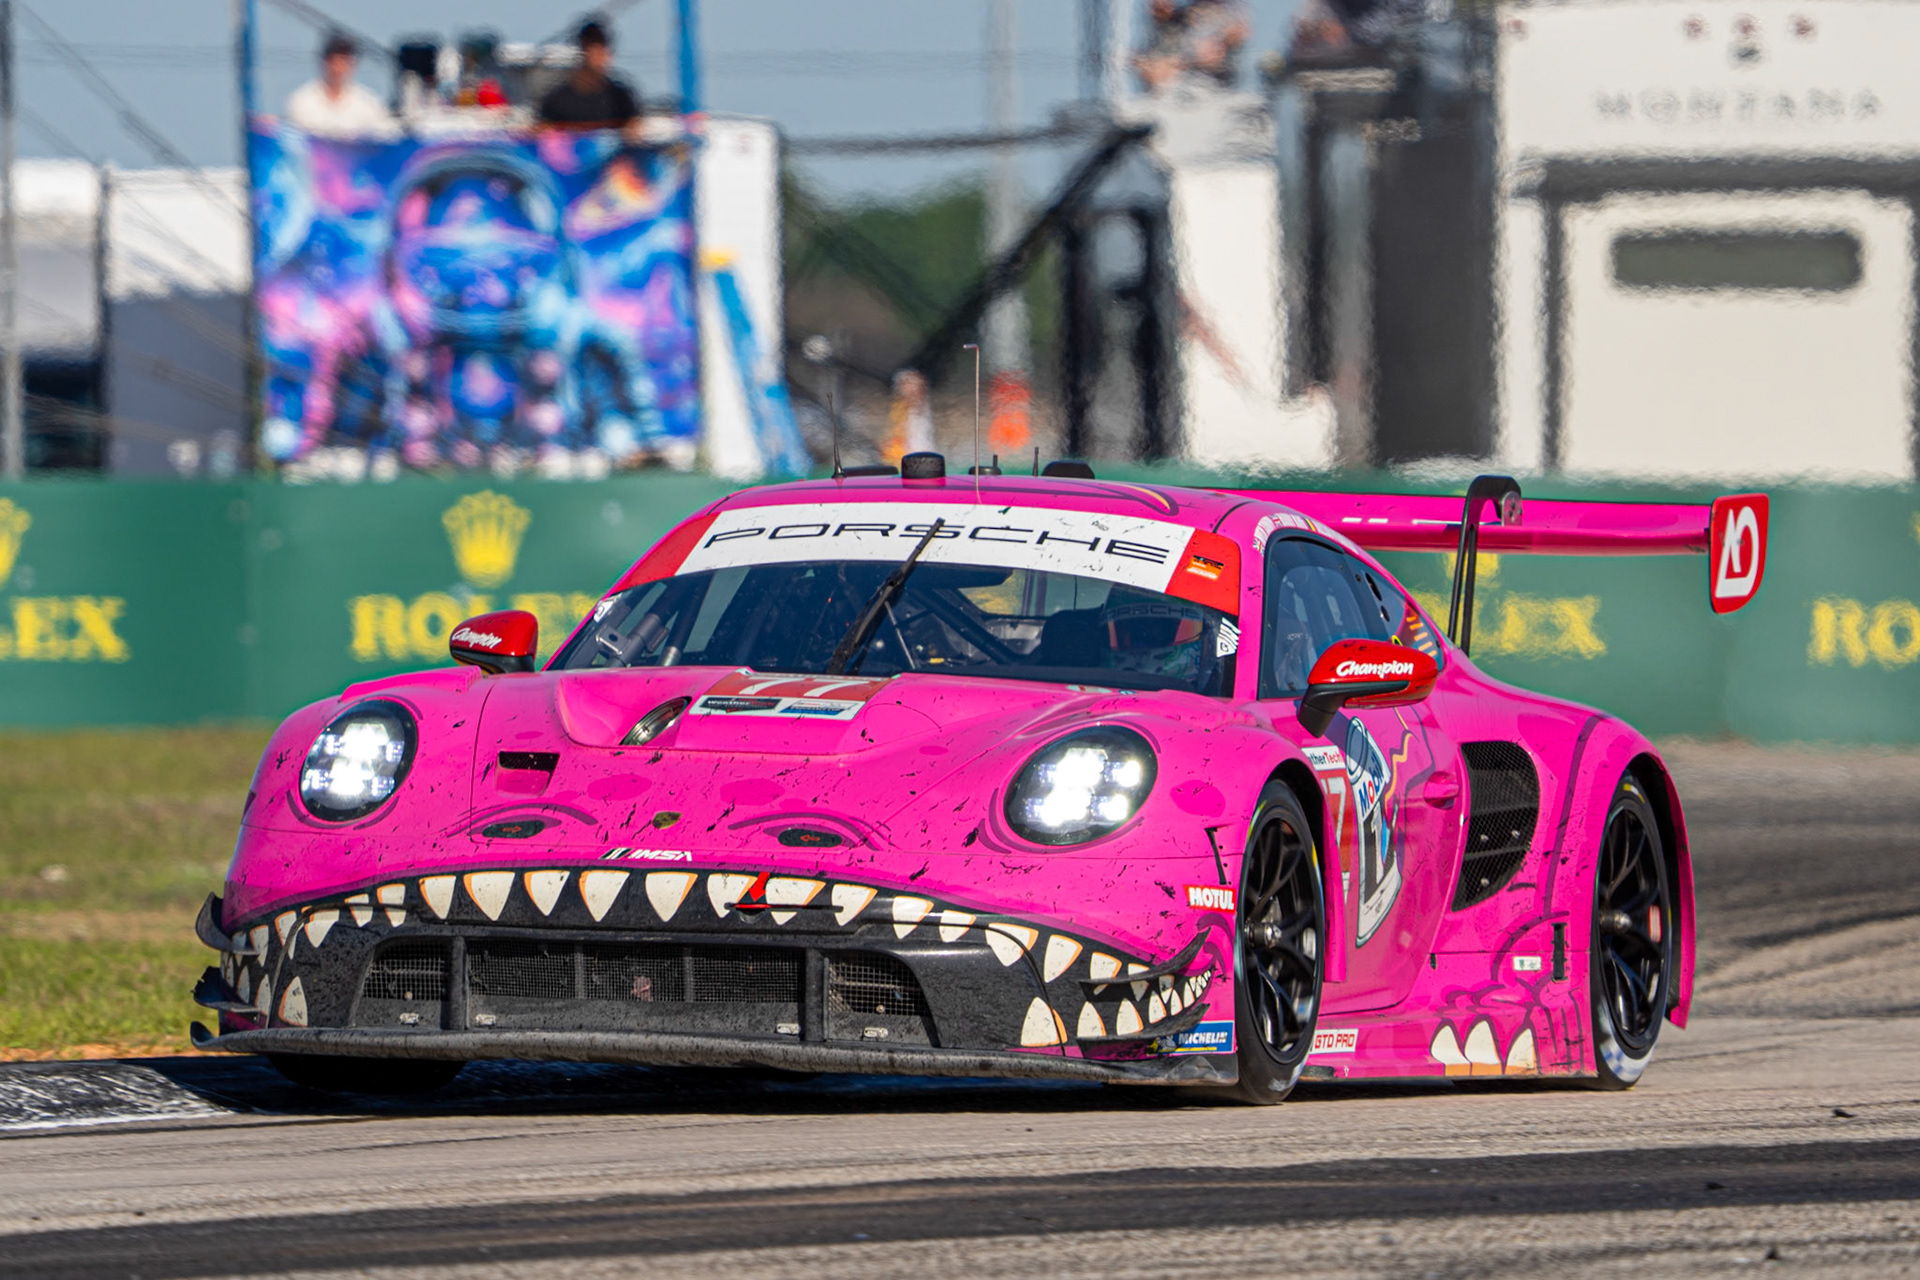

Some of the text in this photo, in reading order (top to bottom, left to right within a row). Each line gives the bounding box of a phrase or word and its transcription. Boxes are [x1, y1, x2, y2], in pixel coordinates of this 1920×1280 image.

[703, 522, 1171, 565] PORSCHE
[0, 596, 130, 662] EX
[452, 628, 502, 649] Champion
[1336, 660, 1414, 679] Champion
[738, 676, 870, 697] 77
[628, 848, 693, 862] IMSA
[1189, 887, 1235, 910] MOTUL
[1179, 1031, 1228, 1045] MICHELIN
[1314, 1033, 1355, 1049] GTD PRO
